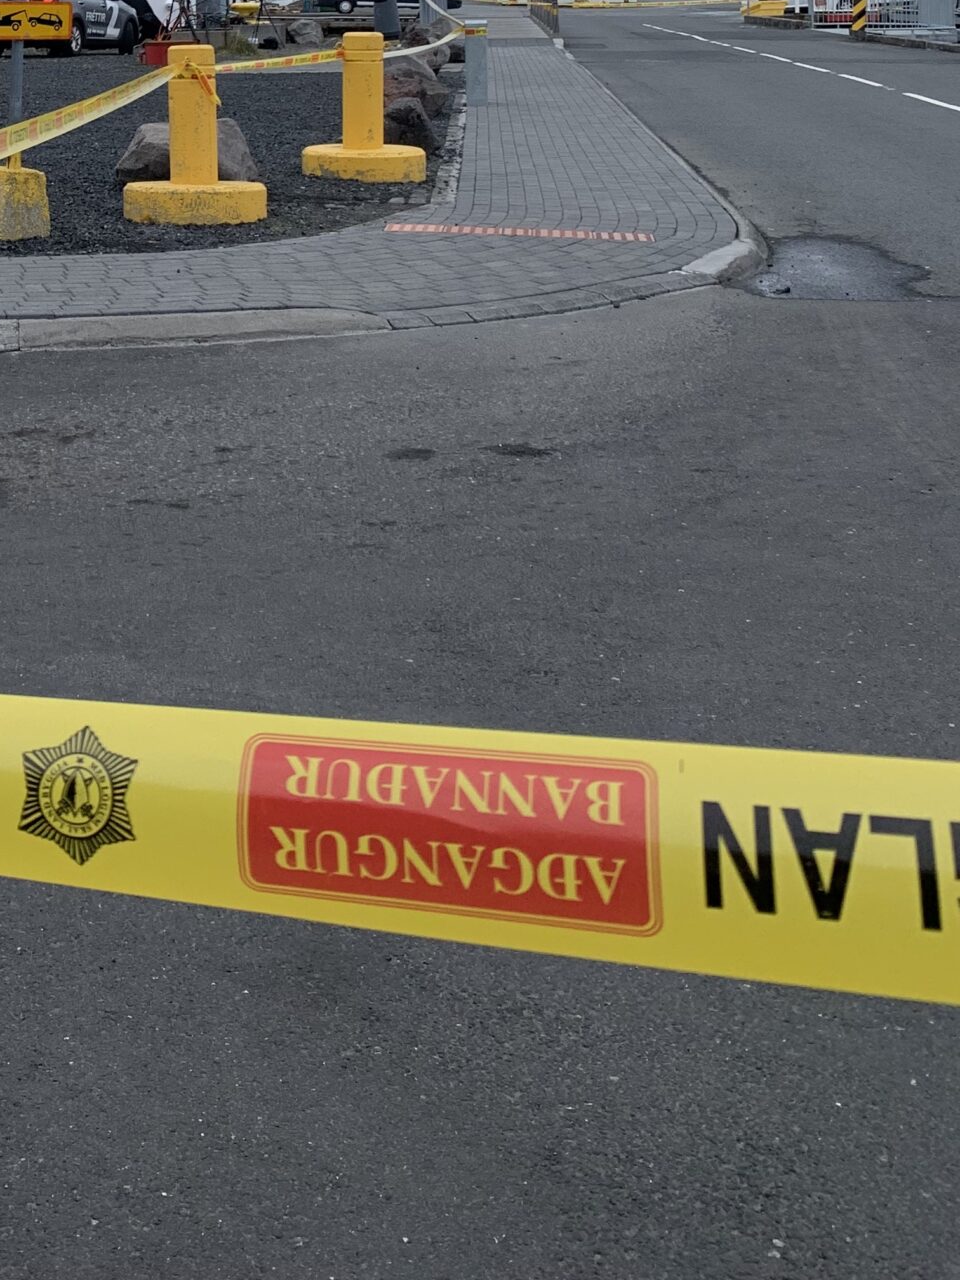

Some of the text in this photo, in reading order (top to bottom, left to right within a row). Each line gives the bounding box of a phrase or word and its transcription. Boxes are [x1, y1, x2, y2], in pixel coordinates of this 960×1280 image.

[285, 755, 624, 825] BANNAÐUR
[269, 826, 626, 905] AÐGANGUR
[701, 800, 960, 932] LAN
